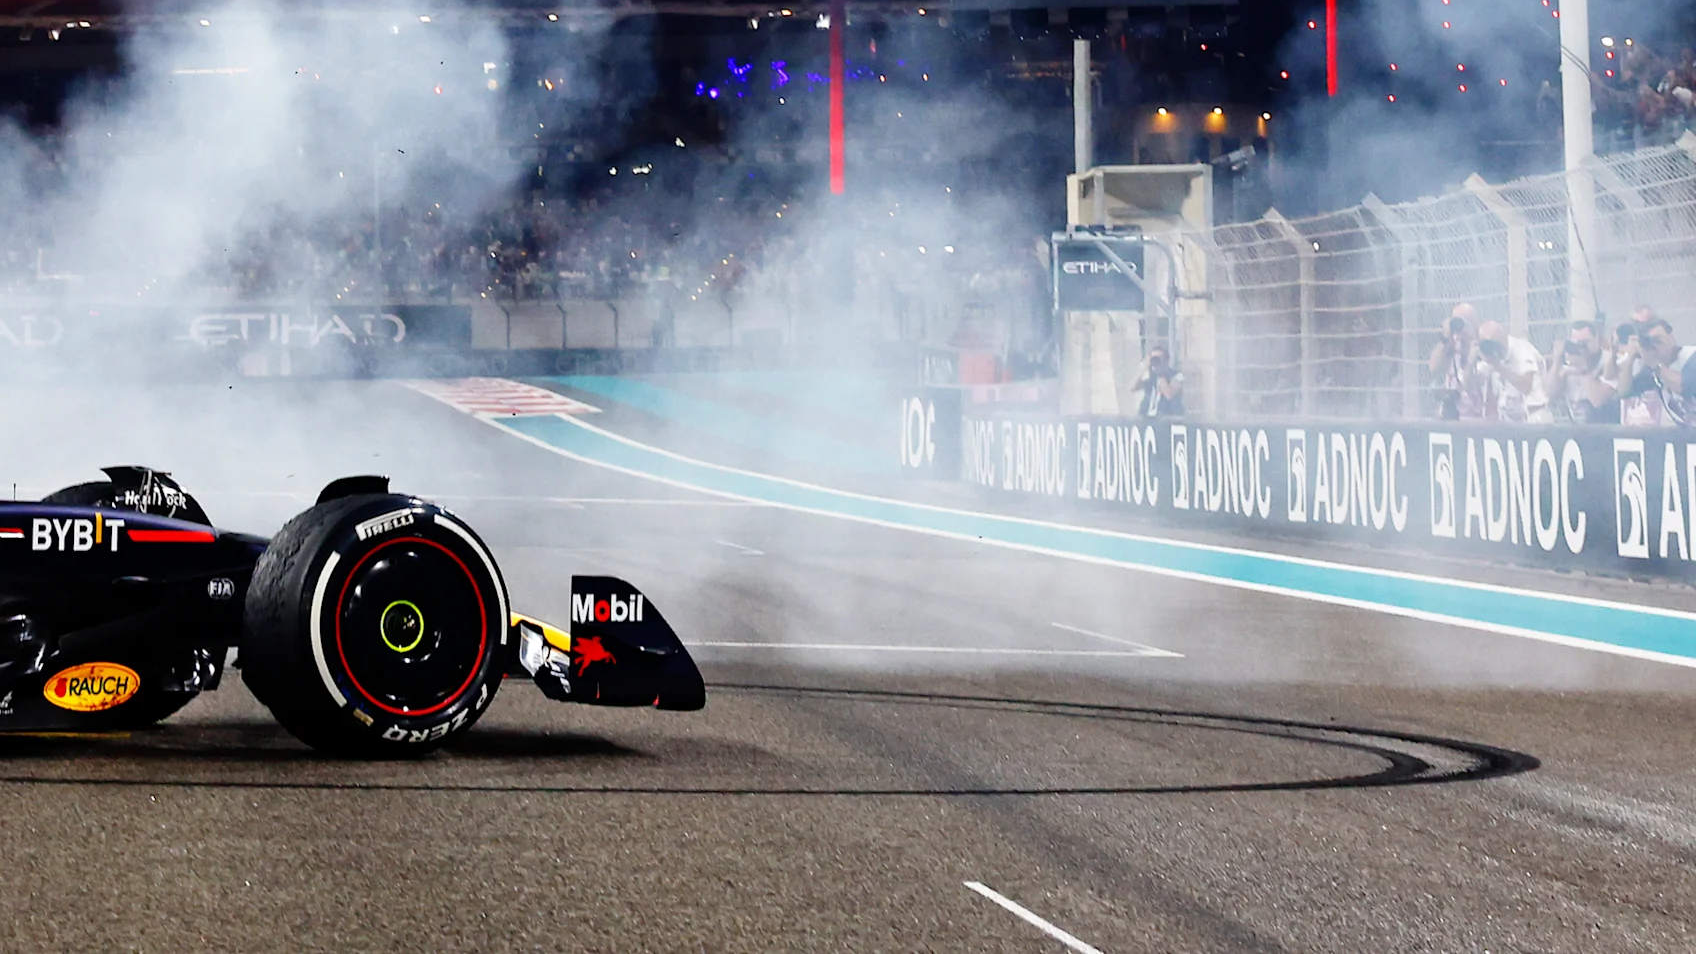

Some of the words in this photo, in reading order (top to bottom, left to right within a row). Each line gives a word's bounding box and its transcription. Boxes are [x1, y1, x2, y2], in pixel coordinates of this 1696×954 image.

[188, 312, 407, 346] ETIHAD
[1015, 422, 1067, 496] ADNOC
[1094, 425, 1159, 506] ADNOC
[1193, 428, 1271, 519] ADNOC
[1312, 430, 1409, 533] ADNOC
[1464, 437, 1587, 555] ADNOC
[31, 511, 125, 552] BYBIT
[355, 507, 415, 542] PIRELLI
[208, 580, 233, 597] FIA
[572, 593, 644, 624] Mobil
[69, 676, 129, 696] RAUCH
[382, 707, 470, 743] ZERO
